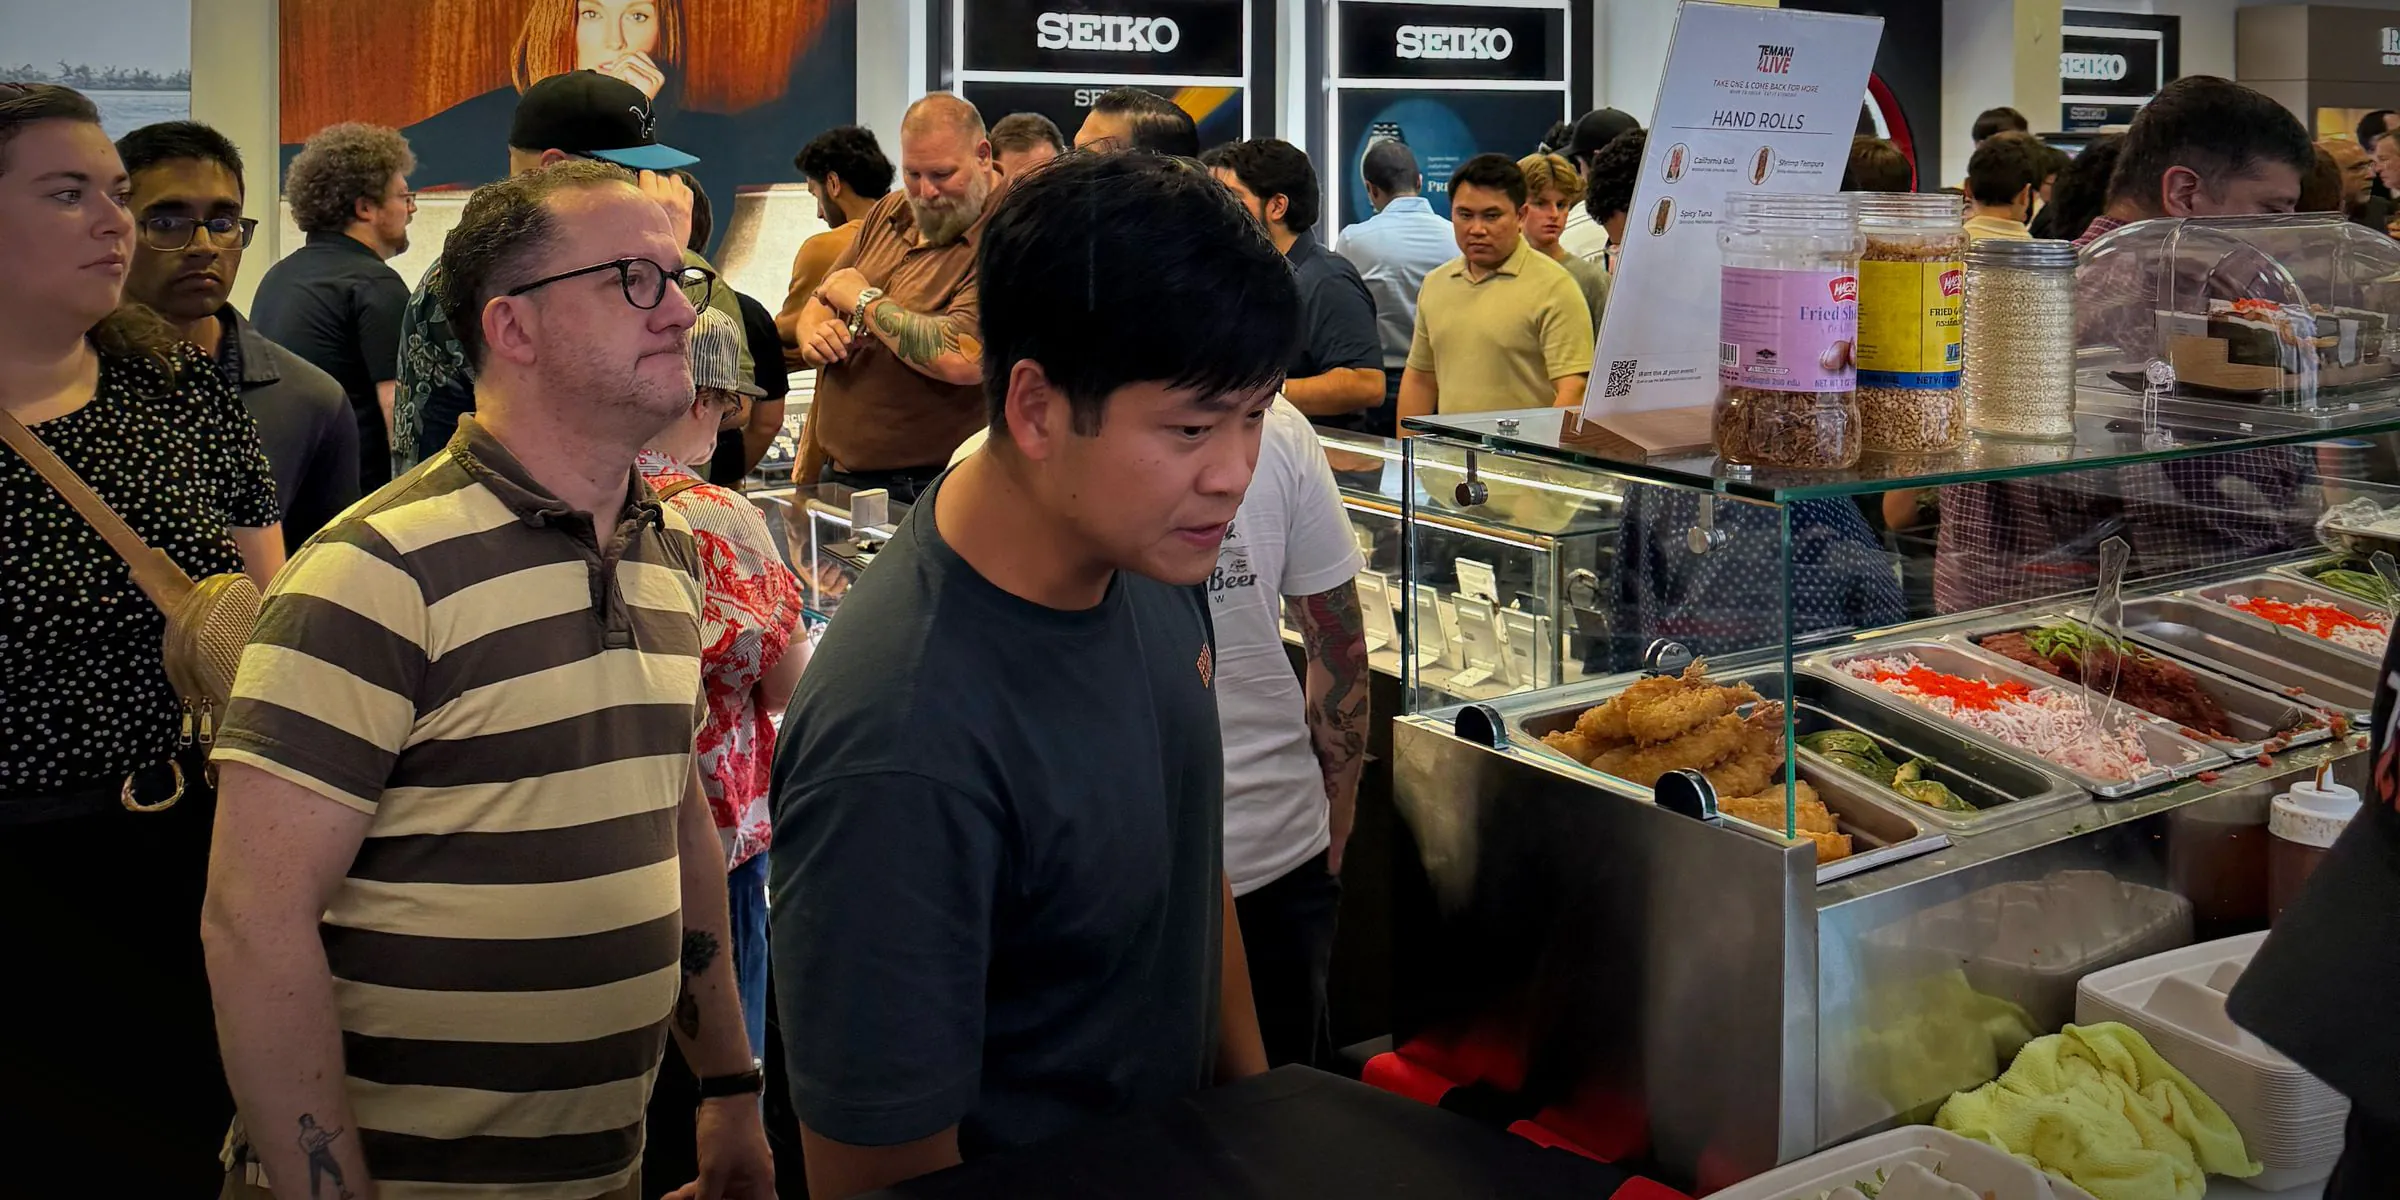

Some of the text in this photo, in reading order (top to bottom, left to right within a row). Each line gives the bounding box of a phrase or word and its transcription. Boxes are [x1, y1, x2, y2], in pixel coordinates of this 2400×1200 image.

[1037, 12, 1180, 53] SEIKO
[1396, 25, 1513, 60] SEIKO
[1758, 44, 1795, 60] TEMAKI
[1713, 79, 1729, 89] TAKE
[1751, 81, 1769, 91] COME
[1770, 83, 1787, 92] BACK
[1787, 83, 1800, 93] FOR
[1801, 84, 1820, 94] MORE
[1712, 110, 1806, 130] HAND ROLLS
[1680, 209, 1697, 219] Spicy
[1800, 305, 1840, 321] Fried
[1929, 307, 1953, 317] FRIED
[1916, 376, 1932, 385] NET
[1208, 566, 1257, 593] Beer
